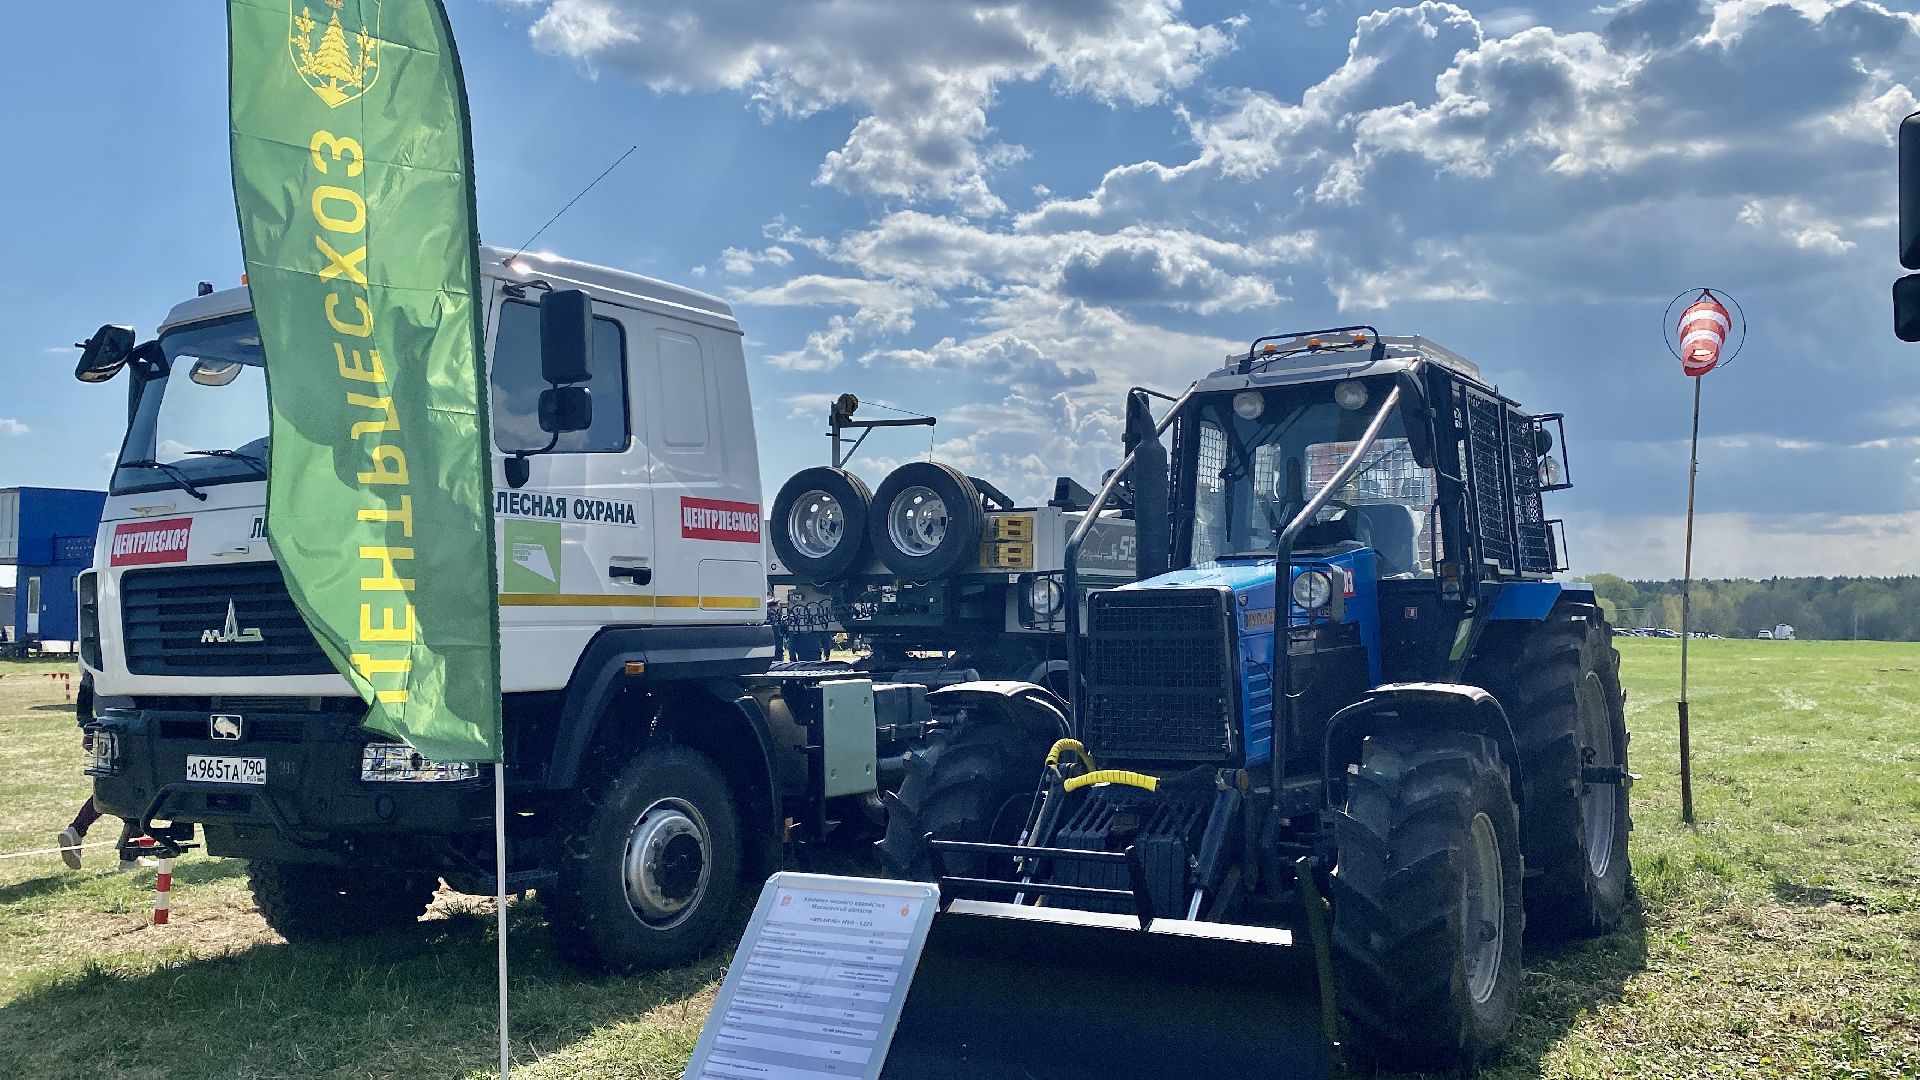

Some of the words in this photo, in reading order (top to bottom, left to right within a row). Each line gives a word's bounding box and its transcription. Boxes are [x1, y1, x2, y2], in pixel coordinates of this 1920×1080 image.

[495, 491, 567, 518] ЛЕСНАЯ
[573, 500, 637, 525] ОХРАНА
[682, 506, 760, 533] ЦЕНТРЛЕСХОЗ
[113, 527, 189, 559] ЦЕНТРЛЕСХОЗ
[190, 758, 240, 781] А965ТА
[242, 759, 262, 776] 790
